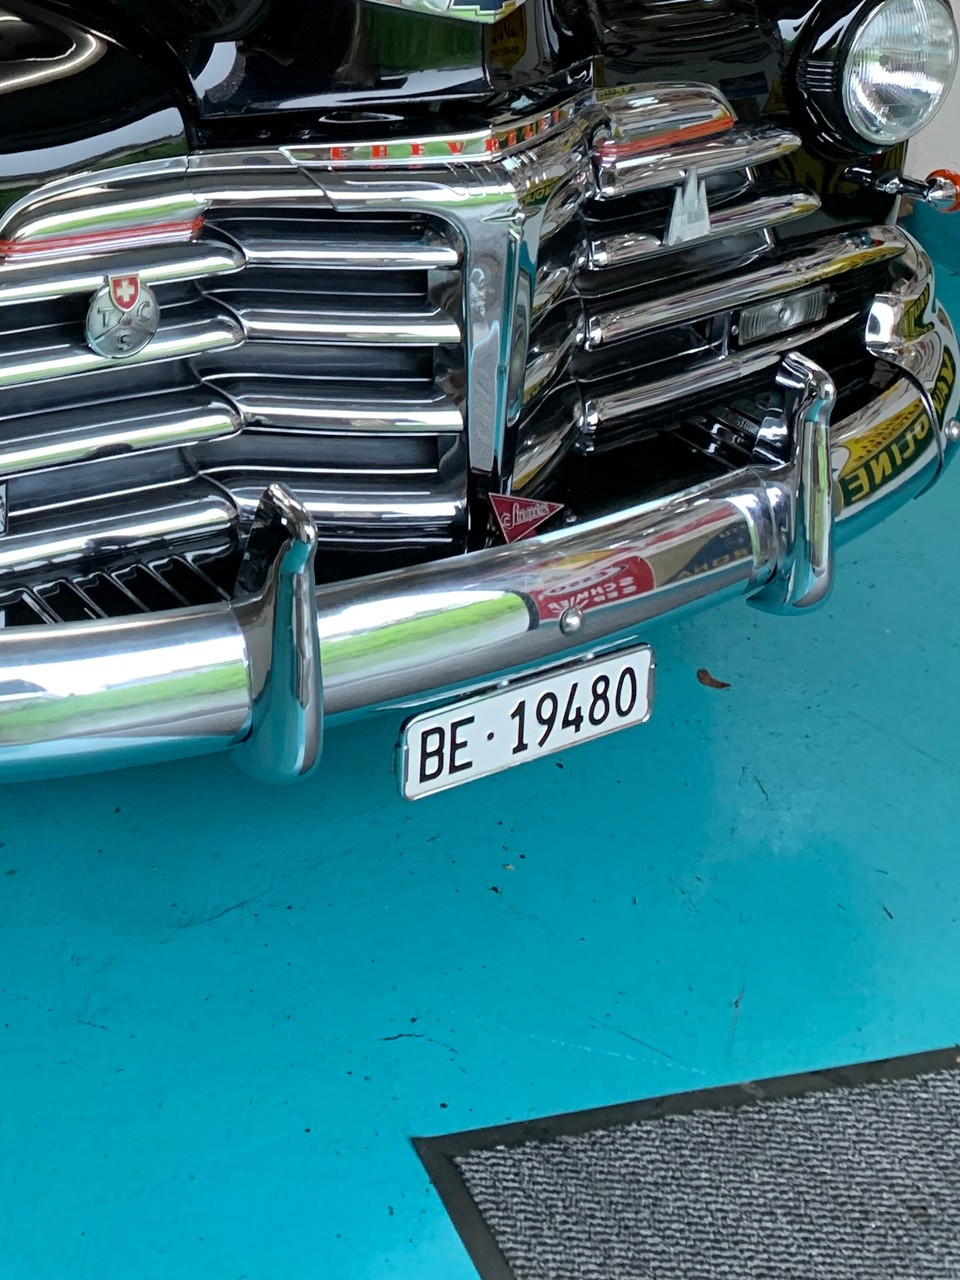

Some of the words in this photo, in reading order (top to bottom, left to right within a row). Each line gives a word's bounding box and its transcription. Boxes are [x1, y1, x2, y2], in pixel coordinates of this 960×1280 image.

[329, 107, 562, 160] CHEVROLET
[418, 715, 475, 784] BE
[510, 666, 637, 755] 19480
